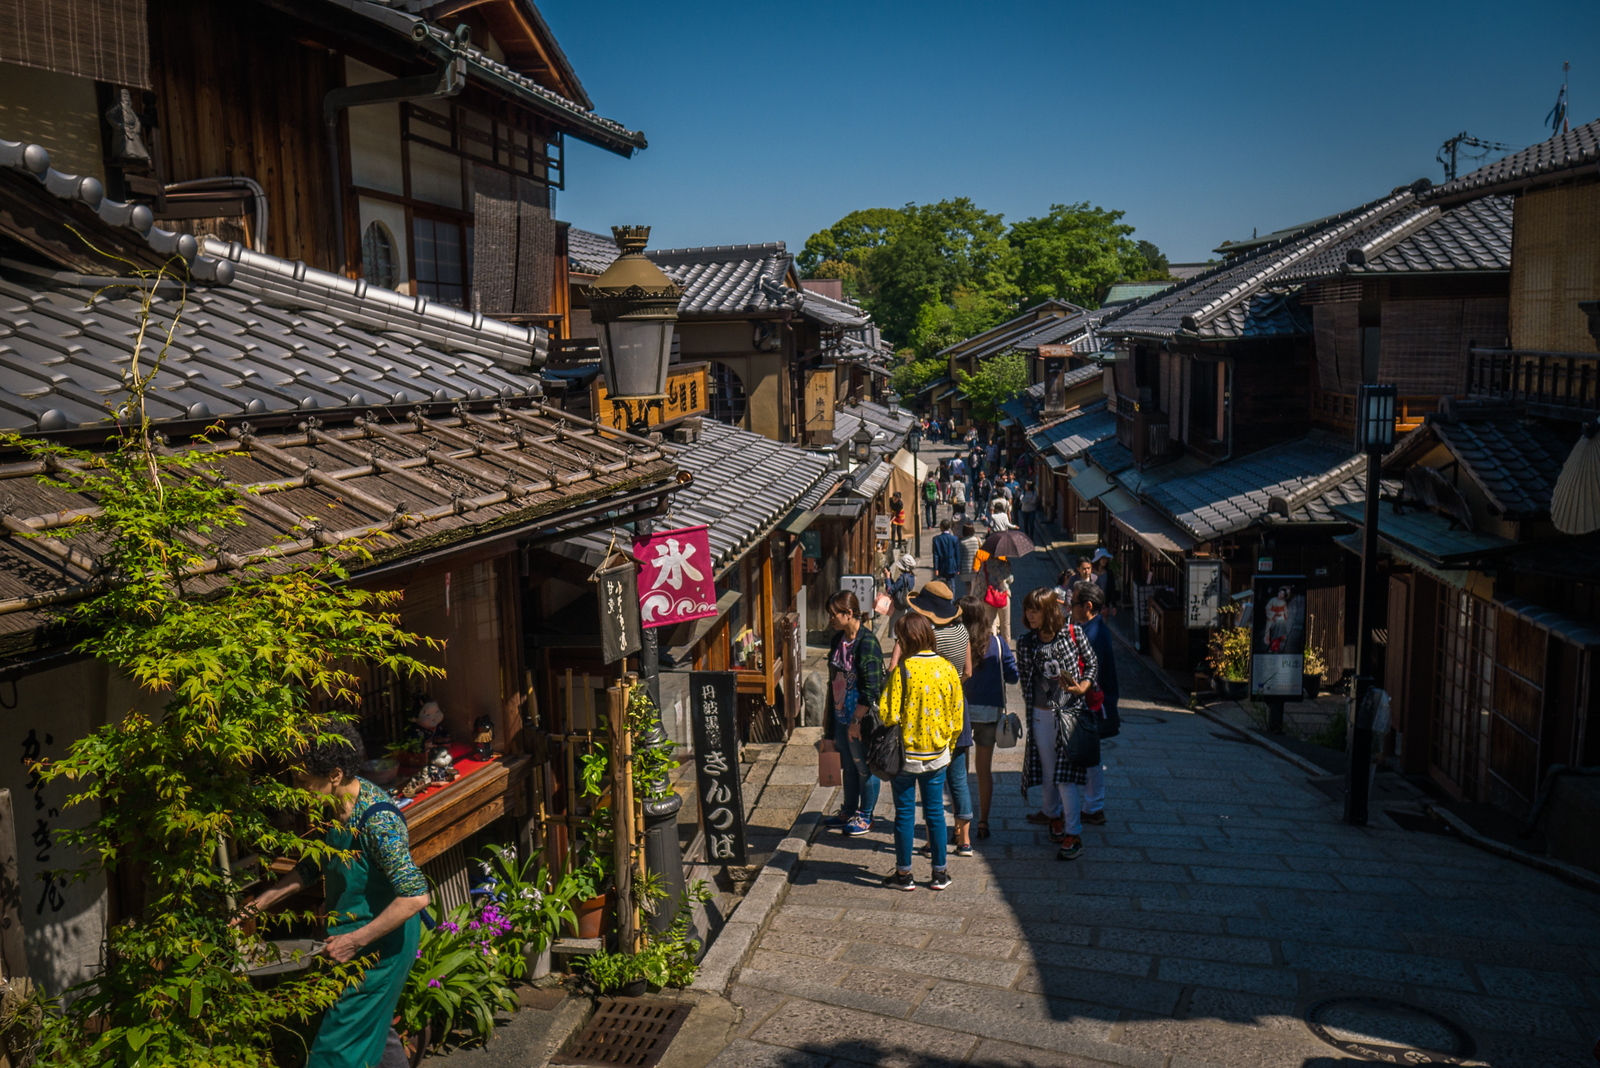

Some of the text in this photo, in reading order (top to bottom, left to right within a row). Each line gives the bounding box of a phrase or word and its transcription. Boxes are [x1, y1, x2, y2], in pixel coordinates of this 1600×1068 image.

[651, 538, 704, 590] 氷
[607, 580, 615, 614] 甘党
[1190, 595, 1201, 620] ふたば
[703, 751, 735, 859] きんつば
